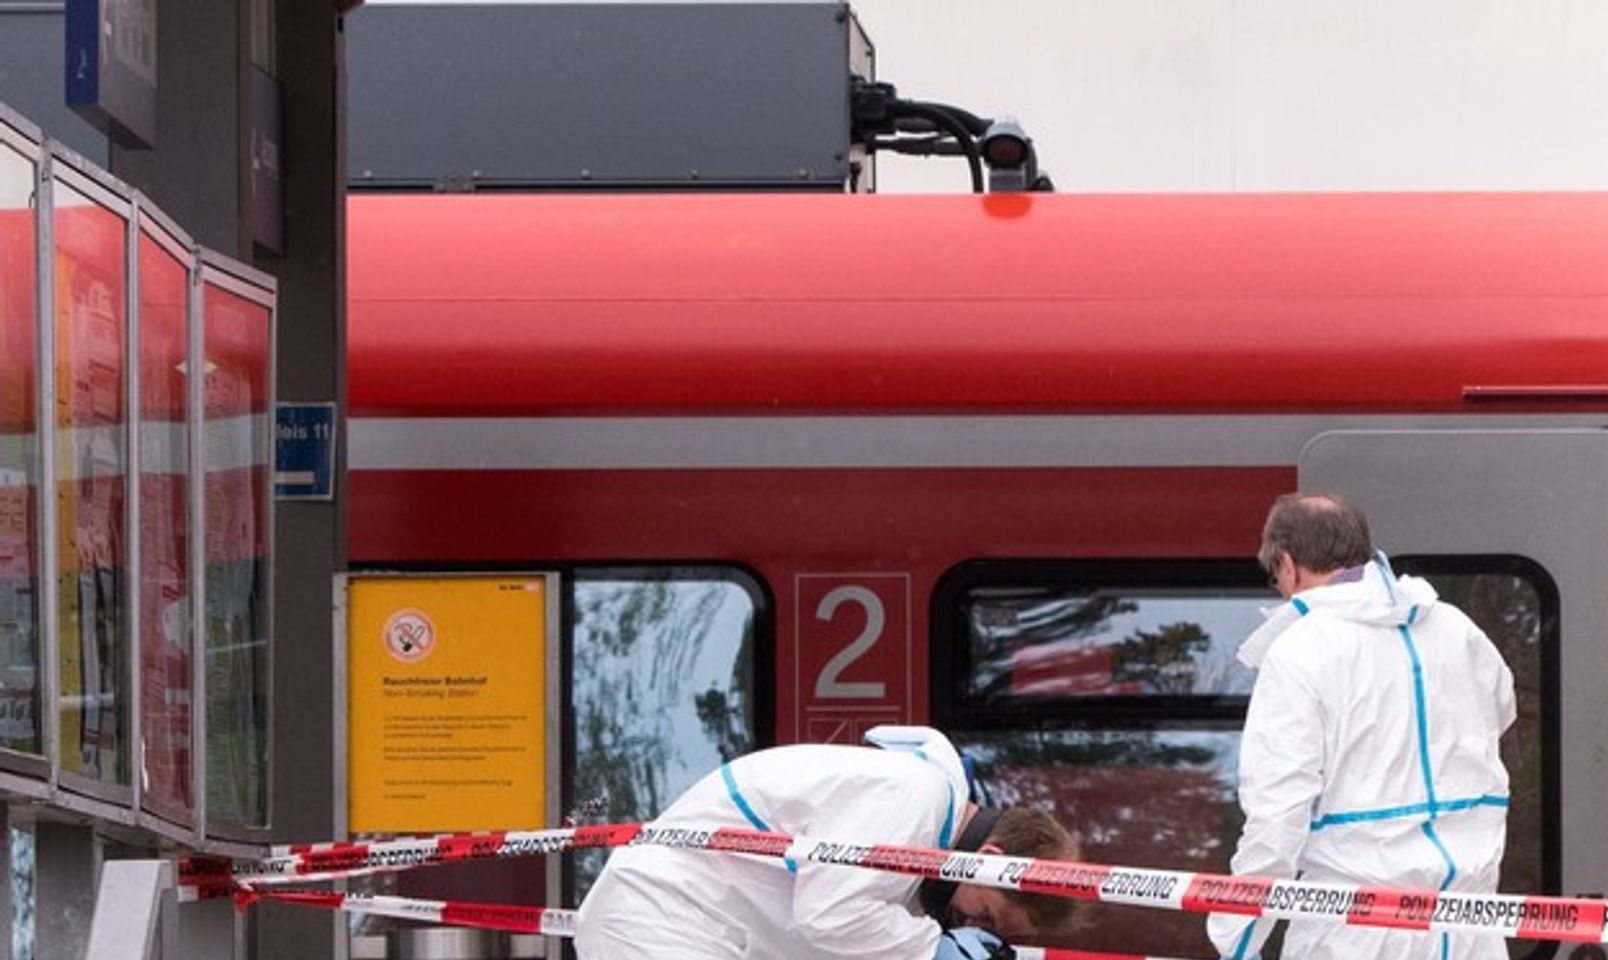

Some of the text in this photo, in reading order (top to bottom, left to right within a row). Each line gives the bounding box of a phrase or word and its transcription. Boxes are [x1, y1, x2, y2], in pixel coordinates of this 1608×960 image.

[313, 422, 329, 439] 11
[814, 584, 886, 699] 2
[998, 861, 1178, 899] POLIZEIABSPERRUNG
[1193, 880, 1378, 918] POLIZEIABSPERRUNG
[1395, 895, 1580, 931] POLIZEIABSPERRUNG
